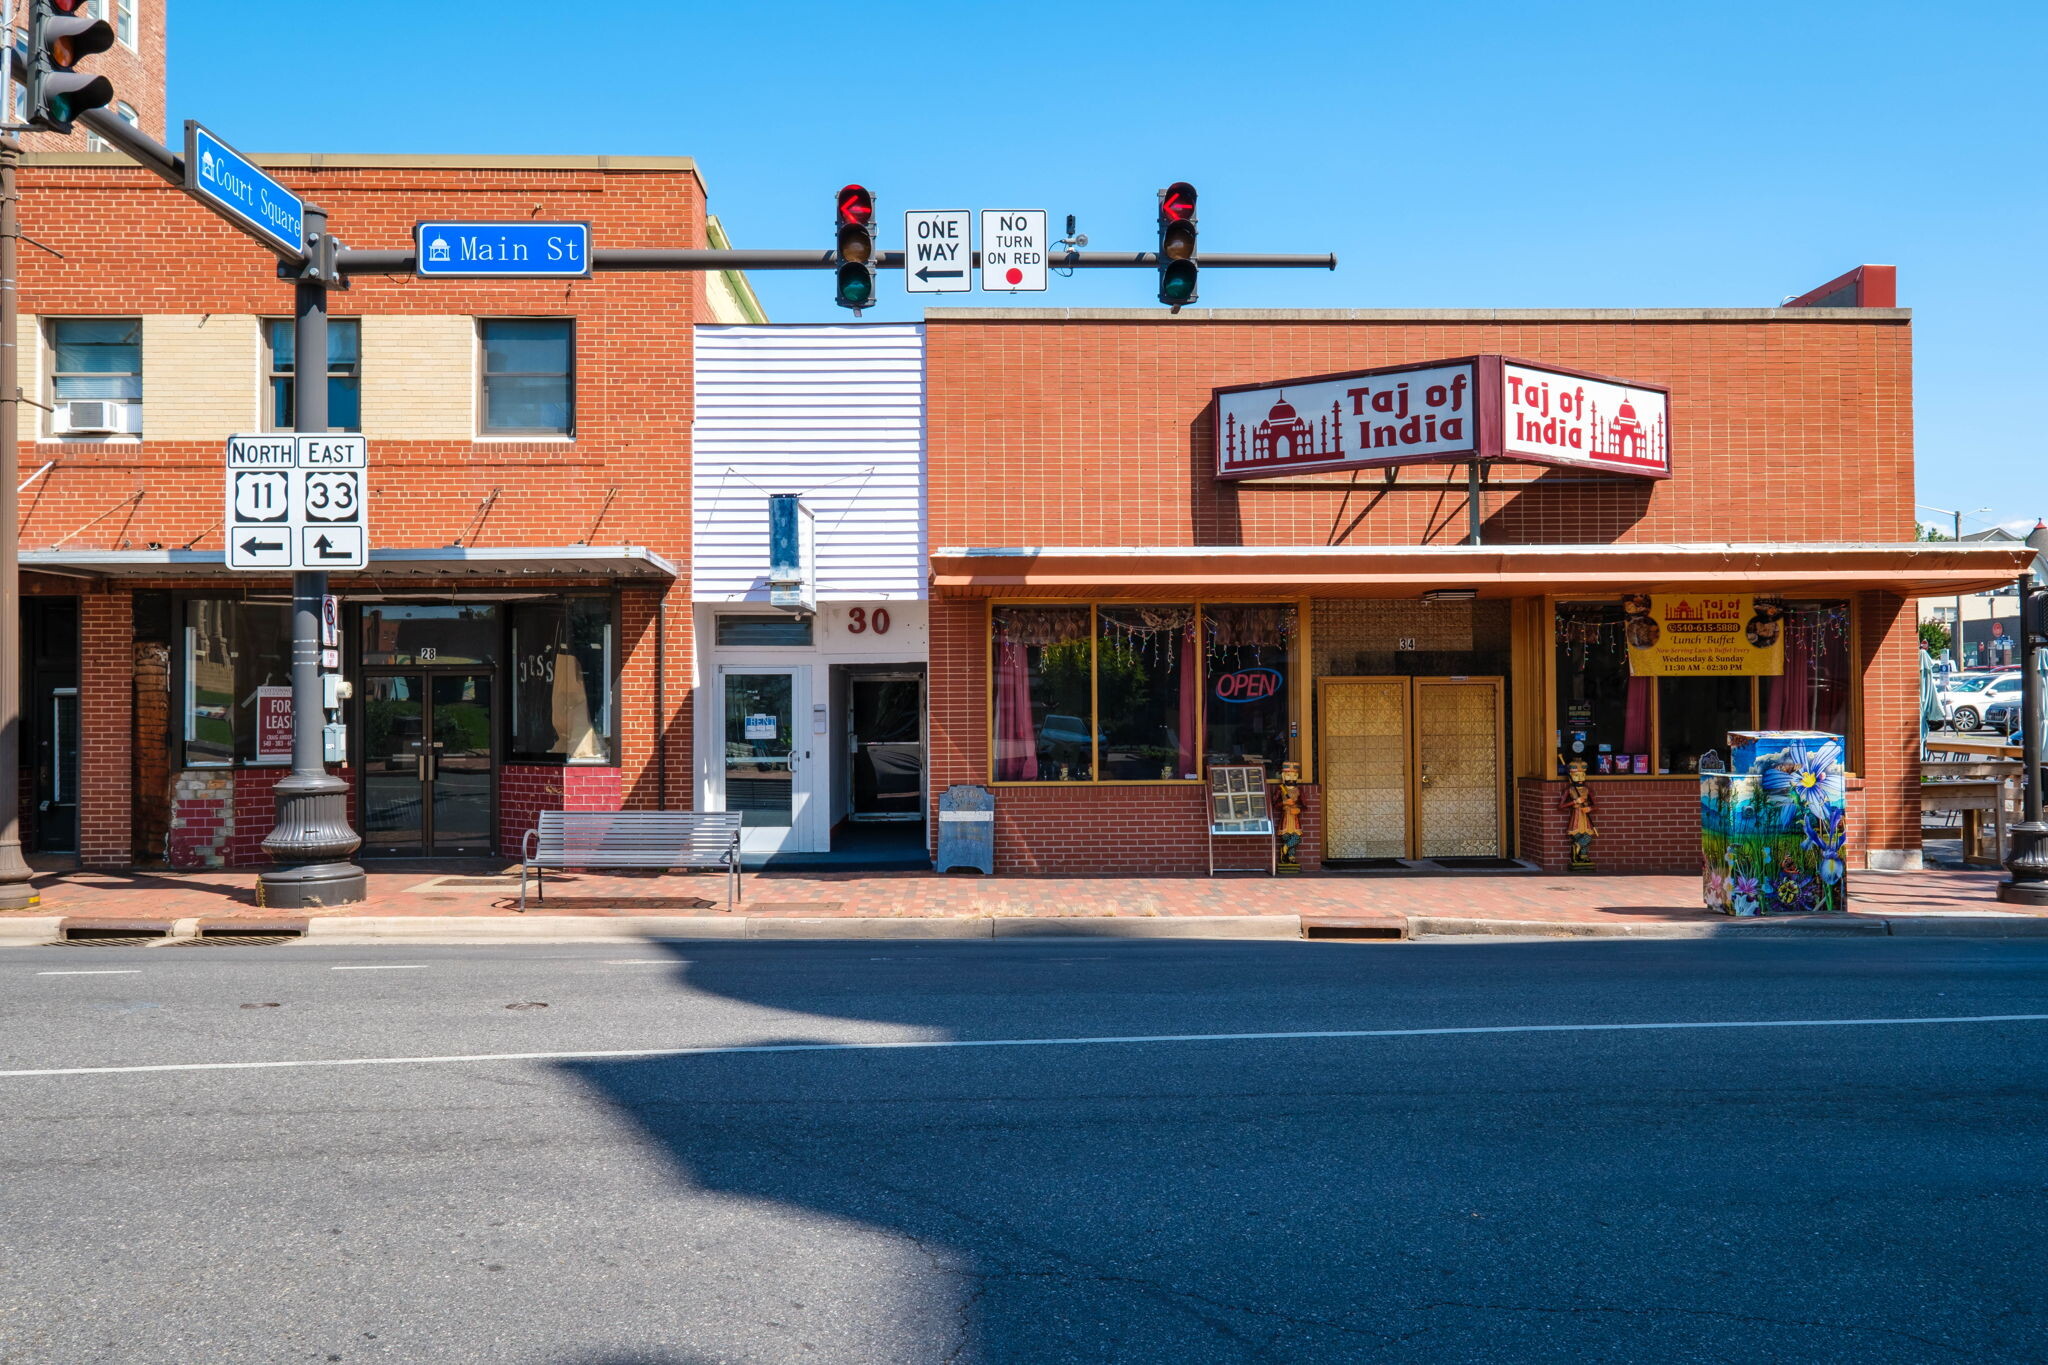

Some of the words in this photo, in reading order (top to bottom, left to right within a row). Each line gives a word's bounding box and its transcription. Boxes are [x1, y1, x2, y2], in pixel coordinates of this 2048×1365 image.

[216, 158, 253, 206] Court
[260, 188, 300, 237] Square
[918, 221, 959, 239] ONE
[1000, 216, 1027, 231] NO
[460, 236, 528, 261] Main
[547, 236, 579, 261] St
[996, 236, 1033, 248] TURN
[917, 243, 959, 261] WAY
[988, 252, 1006, 264] ON
[1014, 252, 1040, 264] RED
[1347, 382, 1409, 419] Taj
[1425, 373, 1467, 412] of
[1507, 375, 1549, 418] Taj
[1559, 386, 1584, 421] of
[1359, 413, 1463, 450] India
[1516, 412, 1582, 450] India
[233, 442, 292, 463] NORTH
[309, 442, 354, 463] EAST
[252, 482, 272, 508] 11
[311, 482, 352, 508] 33
[1703, 600, 1723, 610] Taj
[1728, 599, 1741, 610] of
[847, 607, 890, 634] 30
[1707, 610, 1739, 619] India
[1677, 624, 1739, 632] 540-615-5888
[1400, 638, 1414, 650] 34
[1670, 635, 1701, 644] Lunch
[1704, 635, 1736, 647] Buffet
[422, 649, 435, 660] 28
[1217, 673, 1277, 697] OPEN
[271, 700, 291, 713] FOR
[751, 717, 775, 726] RENT
